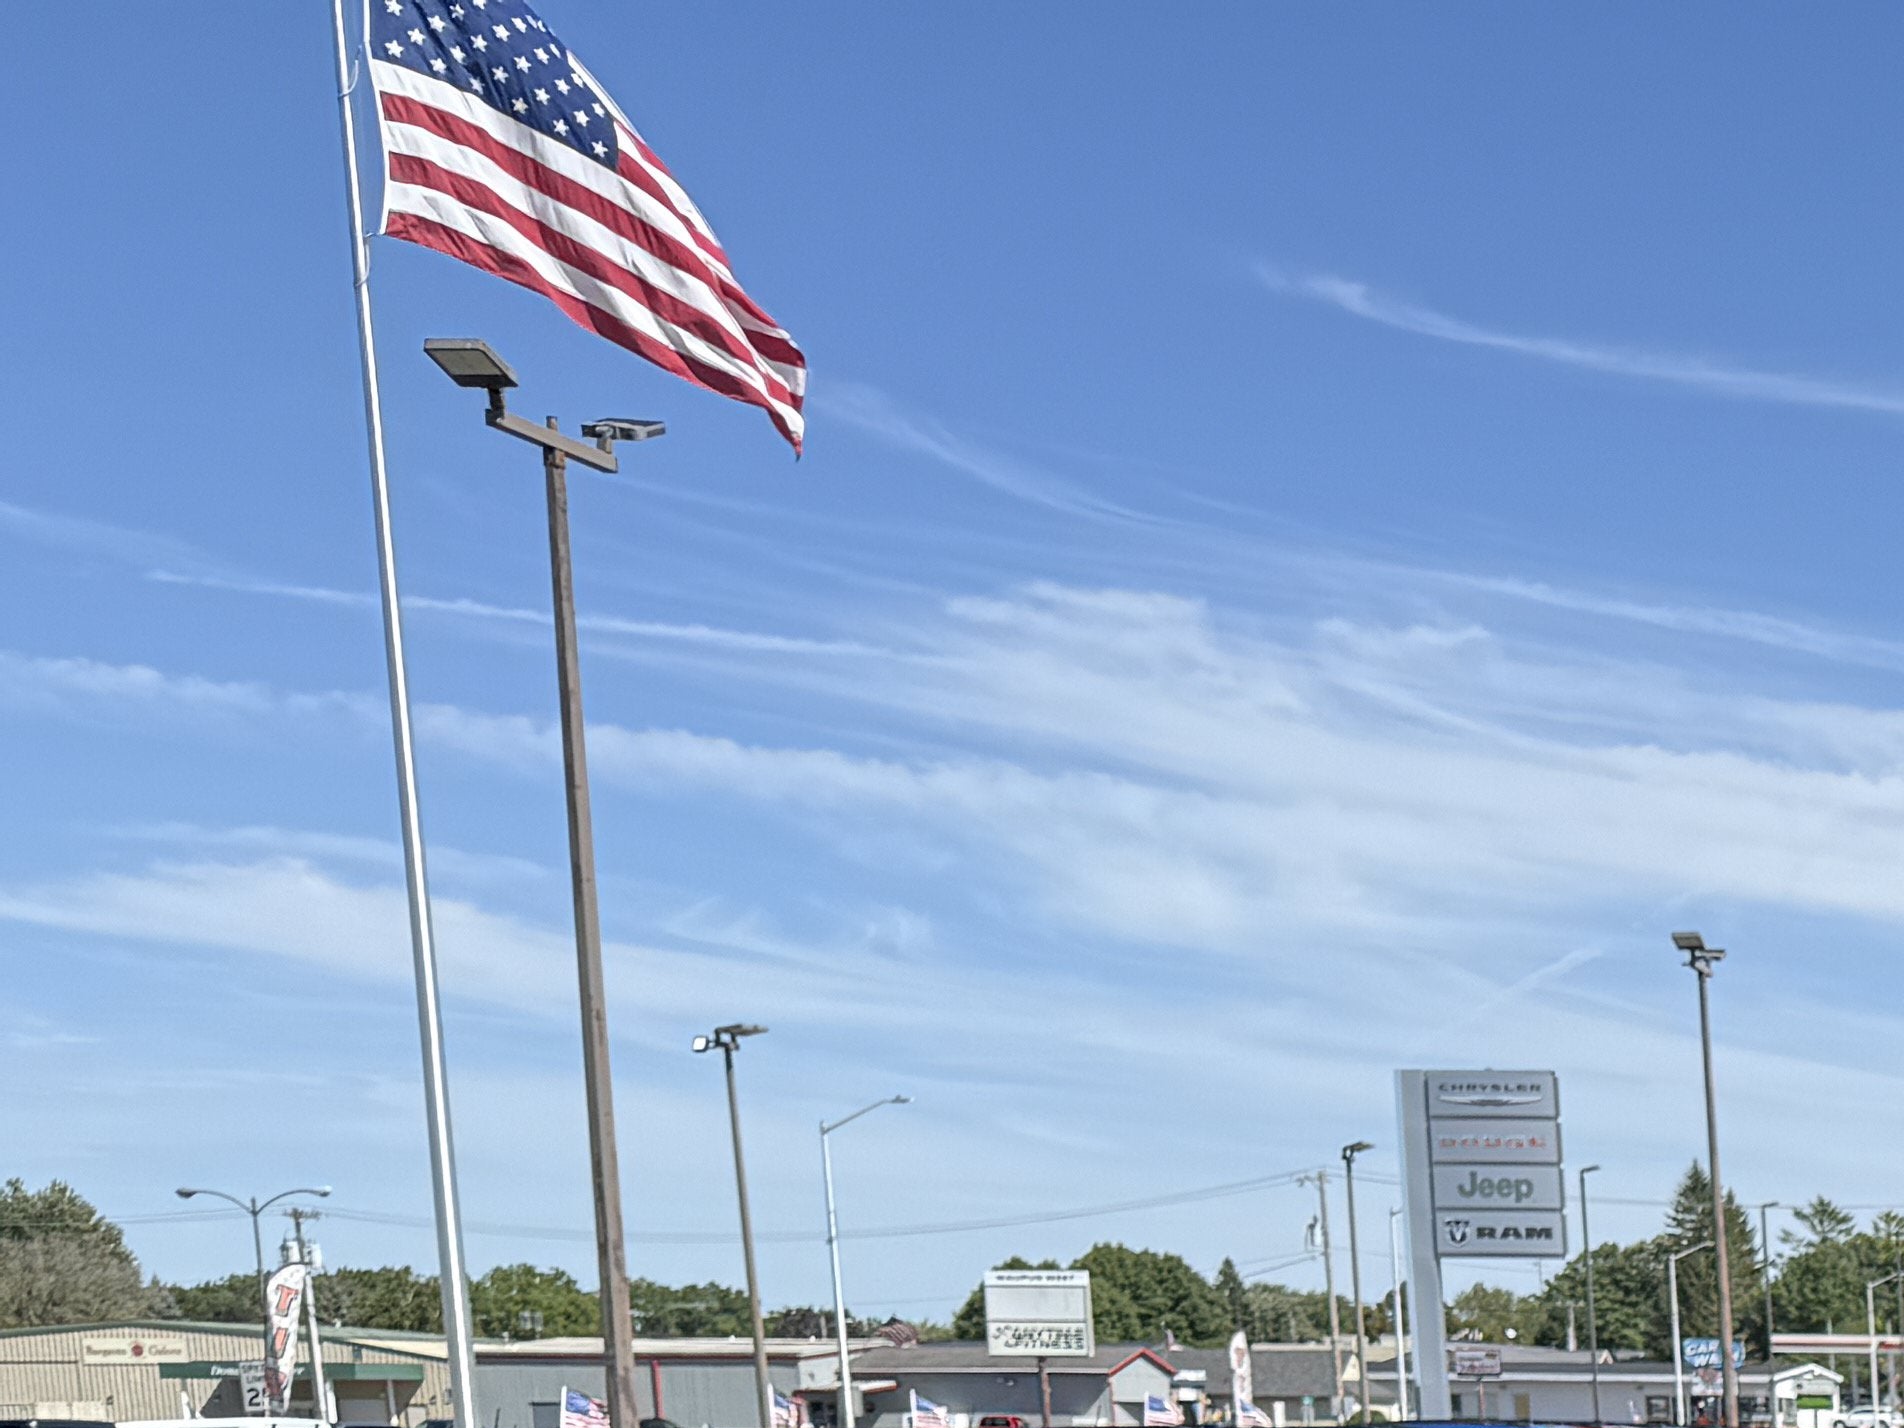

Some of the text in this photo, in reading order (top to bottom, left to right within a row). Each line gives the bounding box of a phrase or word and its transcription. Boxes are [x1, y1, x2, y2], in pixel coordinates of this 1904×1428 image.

[1438, 1083, 1542, 1092] CHRYSLER
[1457, 1171, 1533, 1202] Jeep
[1476, 1226, 1553, 1240] RAM
